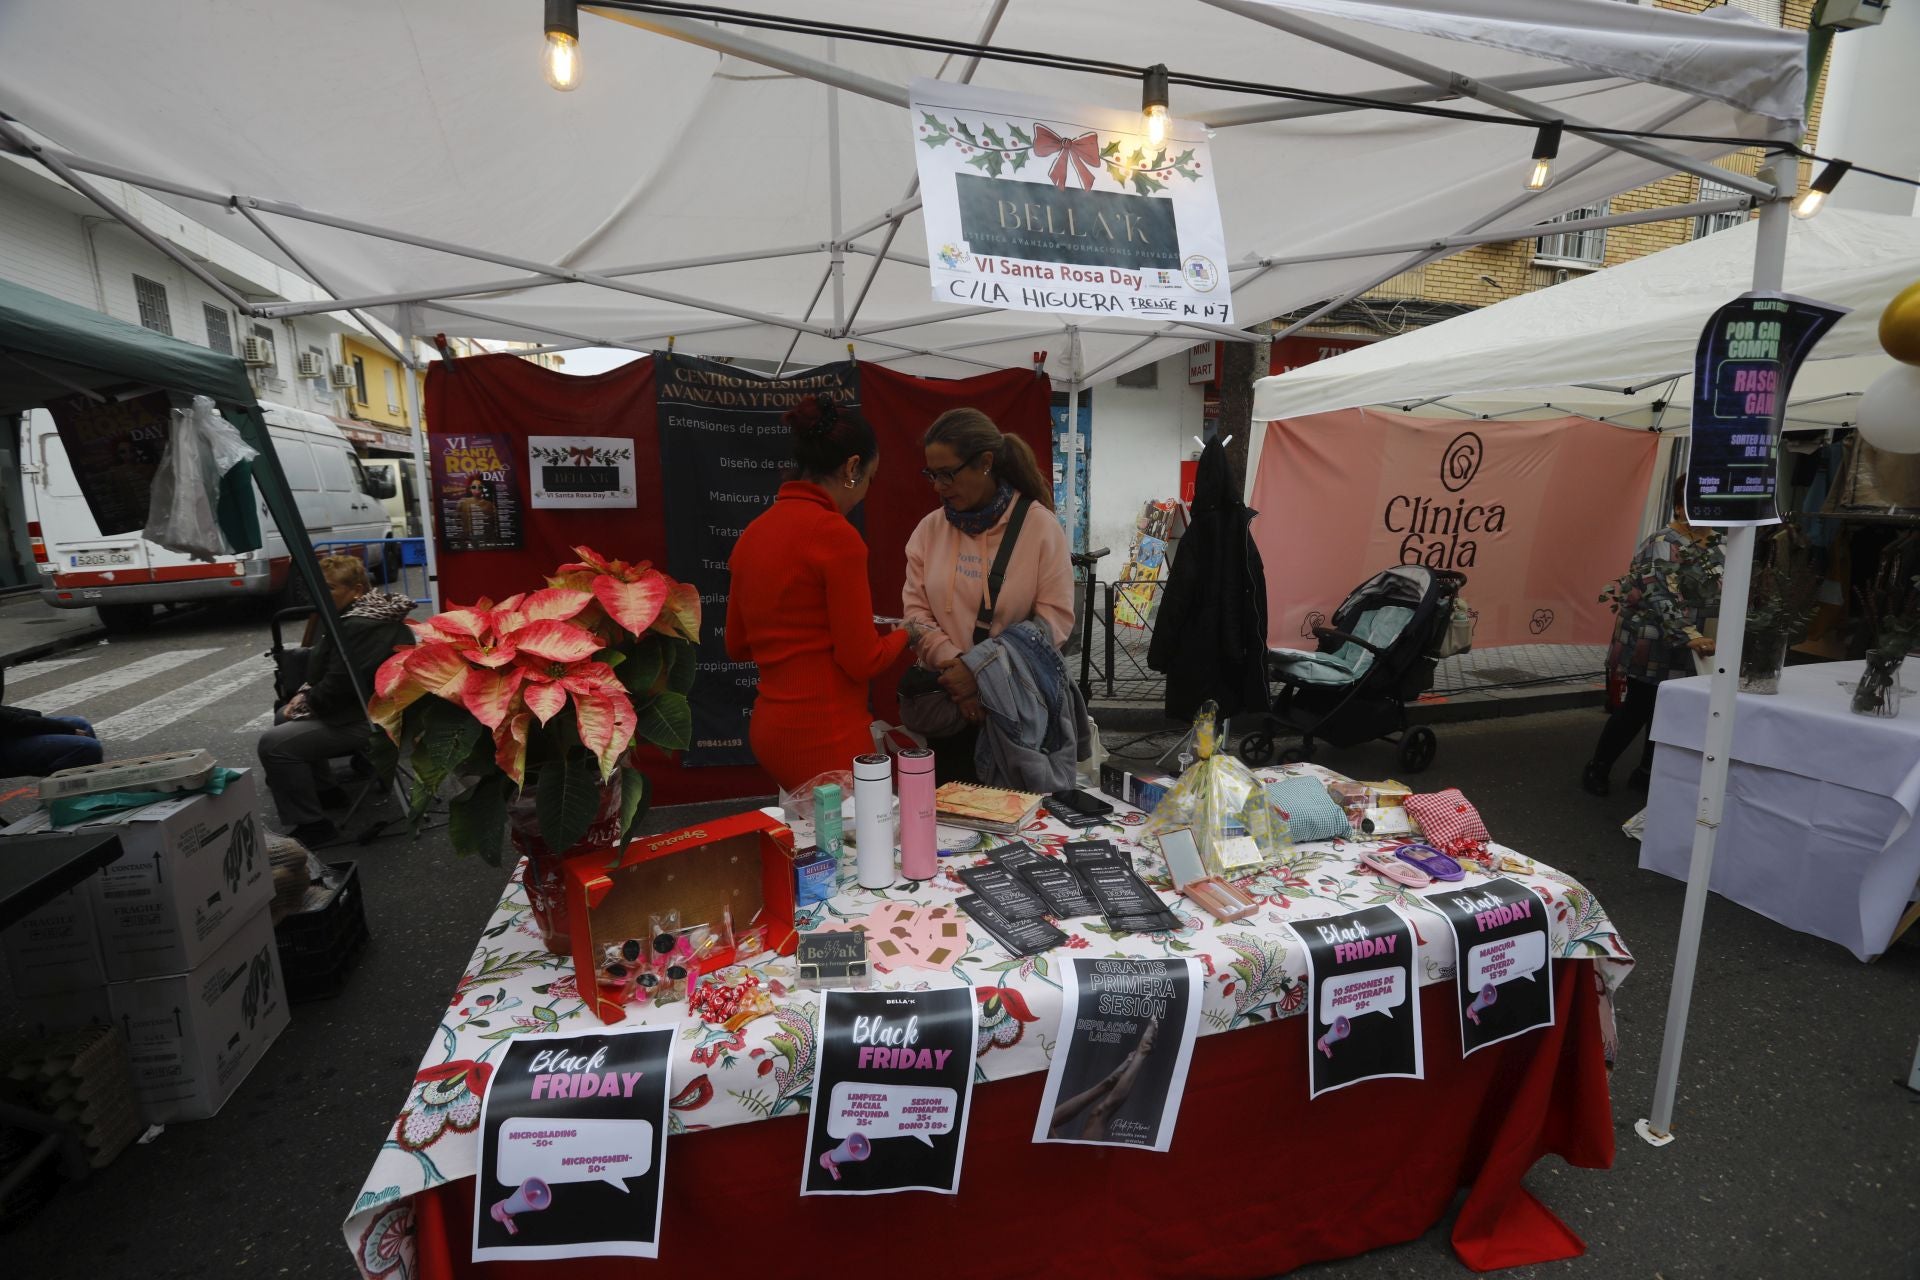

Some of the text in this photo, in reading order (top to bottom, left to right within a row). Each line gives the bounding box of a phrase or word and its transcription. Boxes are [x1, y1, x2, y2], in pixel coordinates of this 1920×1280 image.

[998, 199, 1150, 244] BELLA'K
[975, 256, 1143, 292] VI Santa Rosa Day
[1023, 288, 1125, 313] HIGUERA
[1129, 296, 1178, 311] FRENTE
[1725, 321, 1755, 341] POR
[1193, 342, 1211, 356] MINI
[674, 367, 741, 388] CENTRO
[1191, 363, 1212, 378] MART
[662, 384, 744, 406] AVANZADA
[130, 424, 164, 442] DAY
[668, 415, 735, 434] Extensiones
[739, 423, 753, 435] de
[445, 436, 467, 449] VI
[452, 447, 497, 458] SANTA
[445, 455, 501, 473] ROSA
[720, 456, 758, 469] Diseño
[761, 458, 775, 469] de
[483, 471, 506, 482] DAY
[709, 491, 760, 503] Manicura
[763, 494, 770, 505] y
[1384, 495, 1506, 535] Clínica
[1400, 533, 1477, 570] Gala
[114, 903, 165, 916] FRAGILE
[1452, 891, 1503, 915] Black
[1475, 898, 1532, 933] FRIDAY
[1316, 920, 1371, 945] Black
[1334, 934, 1398, 965] FRIDAY
[1479, 939, 1516, 959] MANICURA
[1490, 951, 1506, 963] CON
[1095, 960, 1168, 977] GRATIS
[1481, 957, 1516, 975] REFUERZO
[1090, 973, 1177, 999] PRIMERA
[1333, 975, 1395, 997] 10 SESIONES DE
[1331, 985, 1393, 1008] PRESOTERAPIA
[1099, 994, 1168, 1020] SESIÓN
[851, 1015, 920, 1049] Black
[1077, 1018, 1138, 1035] DEPILACIÓN
[528, 1045, 610, 1075] Black
[857, 1046, 953, 1071] FRIDAY
[530, 1071, 645, 1100] FRIDAY
[847, 1093, 888, 1102] LIMPIEZA
[851, 1101, 882, 1110] FACIAL
[911, 1098, 943, 1107] SESION
[841, 1109, 890, 1118] PROFUNDA
[901, 1105, 949, 1114] DERMAPEN
[508, 1129, 578, 1140] MICROBLADING
[898, 1122, 924, 1131] BONO
[924, 1121, 930, 1130] 3
